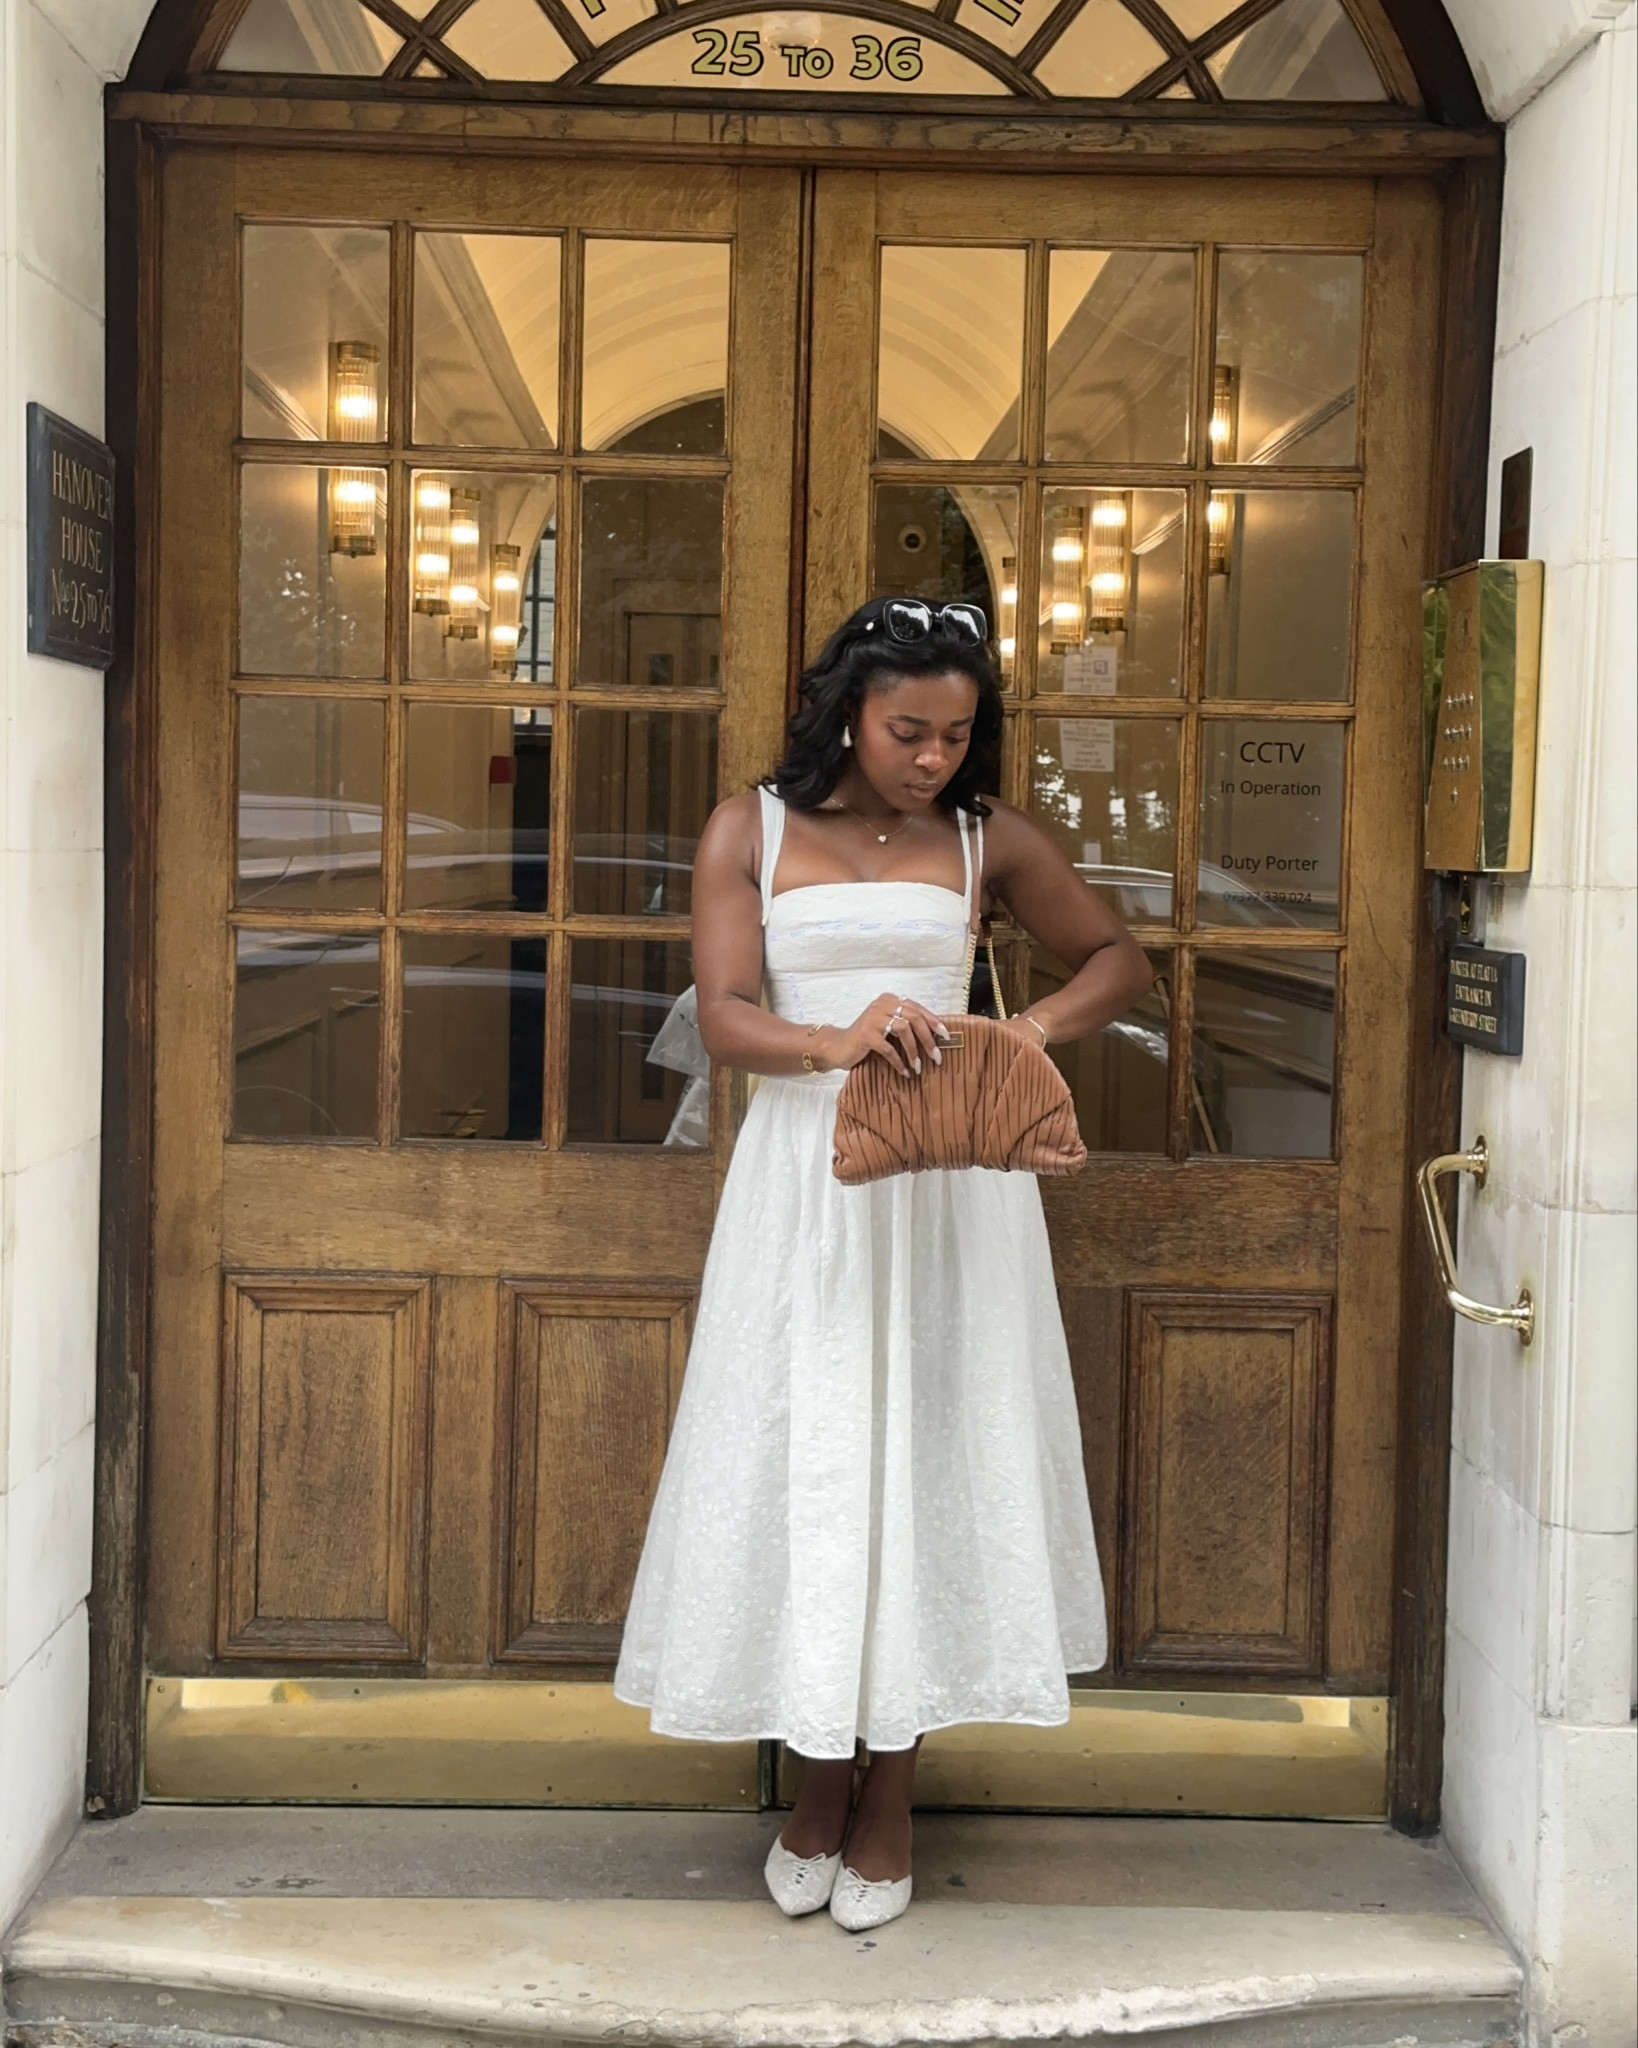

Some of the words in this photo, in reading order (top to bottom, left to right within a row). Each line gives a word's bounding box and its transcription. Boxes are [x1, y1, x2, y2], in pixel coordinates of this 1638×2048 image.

[692, 29, 764, 75] 25
[781, 45, 834, 79] TO
[849, 35, 923, 81] 36
[52, 450, 112, 521] HANOVER
[61, 516, 103, 574] HOUSE
[71, 580, 86, 629] 25
[97, 588, 112, 635] 36
[1240, 741, 1305, 764] CCTV
[1220, 780, 1235, 794] In
[1240, 780, 1321, 798] Operation
[1221, 855, 1261, 873] Duty
[1266, 856, 1319, 871] Porter
[1289, 892, 1311, 904] 024
